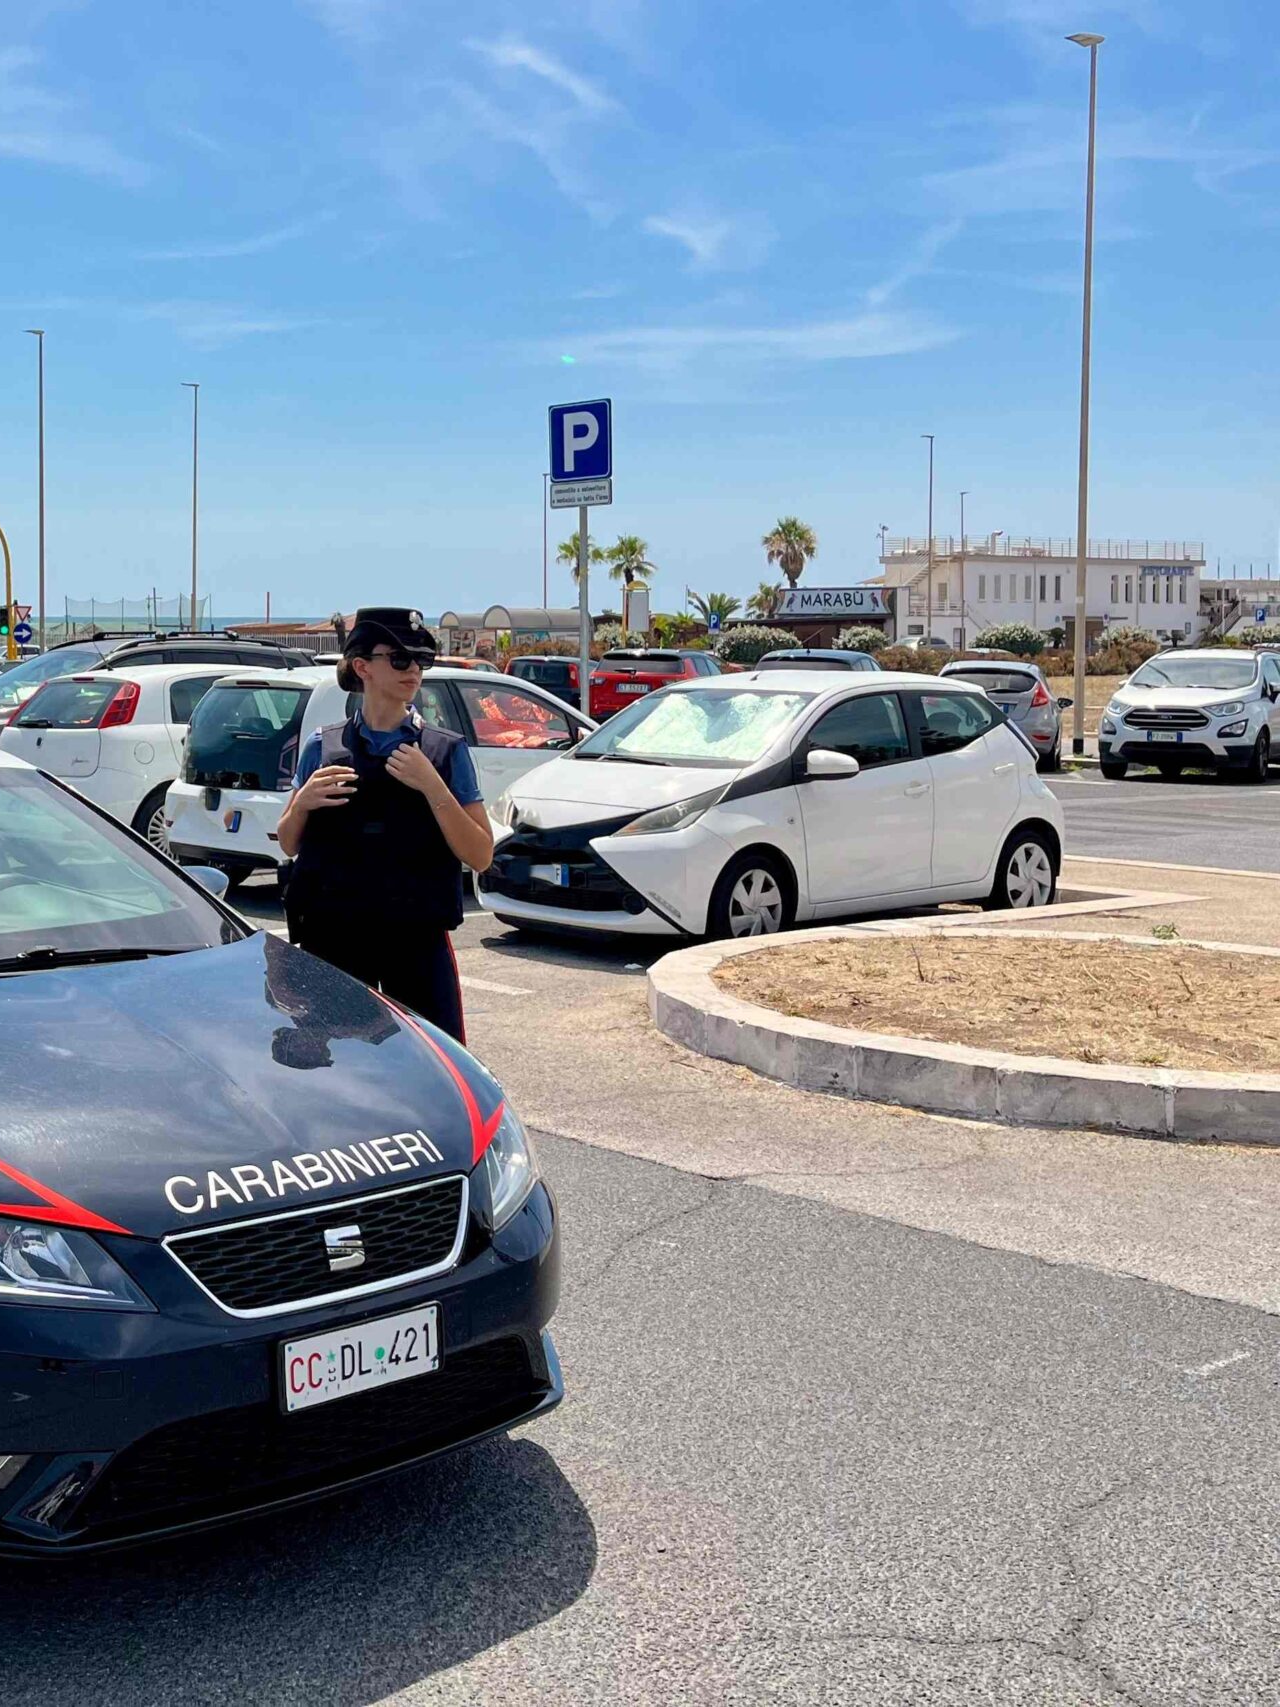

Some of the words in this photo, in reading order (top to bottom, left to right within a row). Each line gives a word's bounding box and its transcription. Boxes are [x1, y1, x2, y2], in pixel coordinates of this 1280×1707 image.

[563, 411, 599, 472] P
[710, 614, 718, 628] P
[1256, 609, 1264, 620] P
[164, 1130, 444, 1214] CARABINIERI
